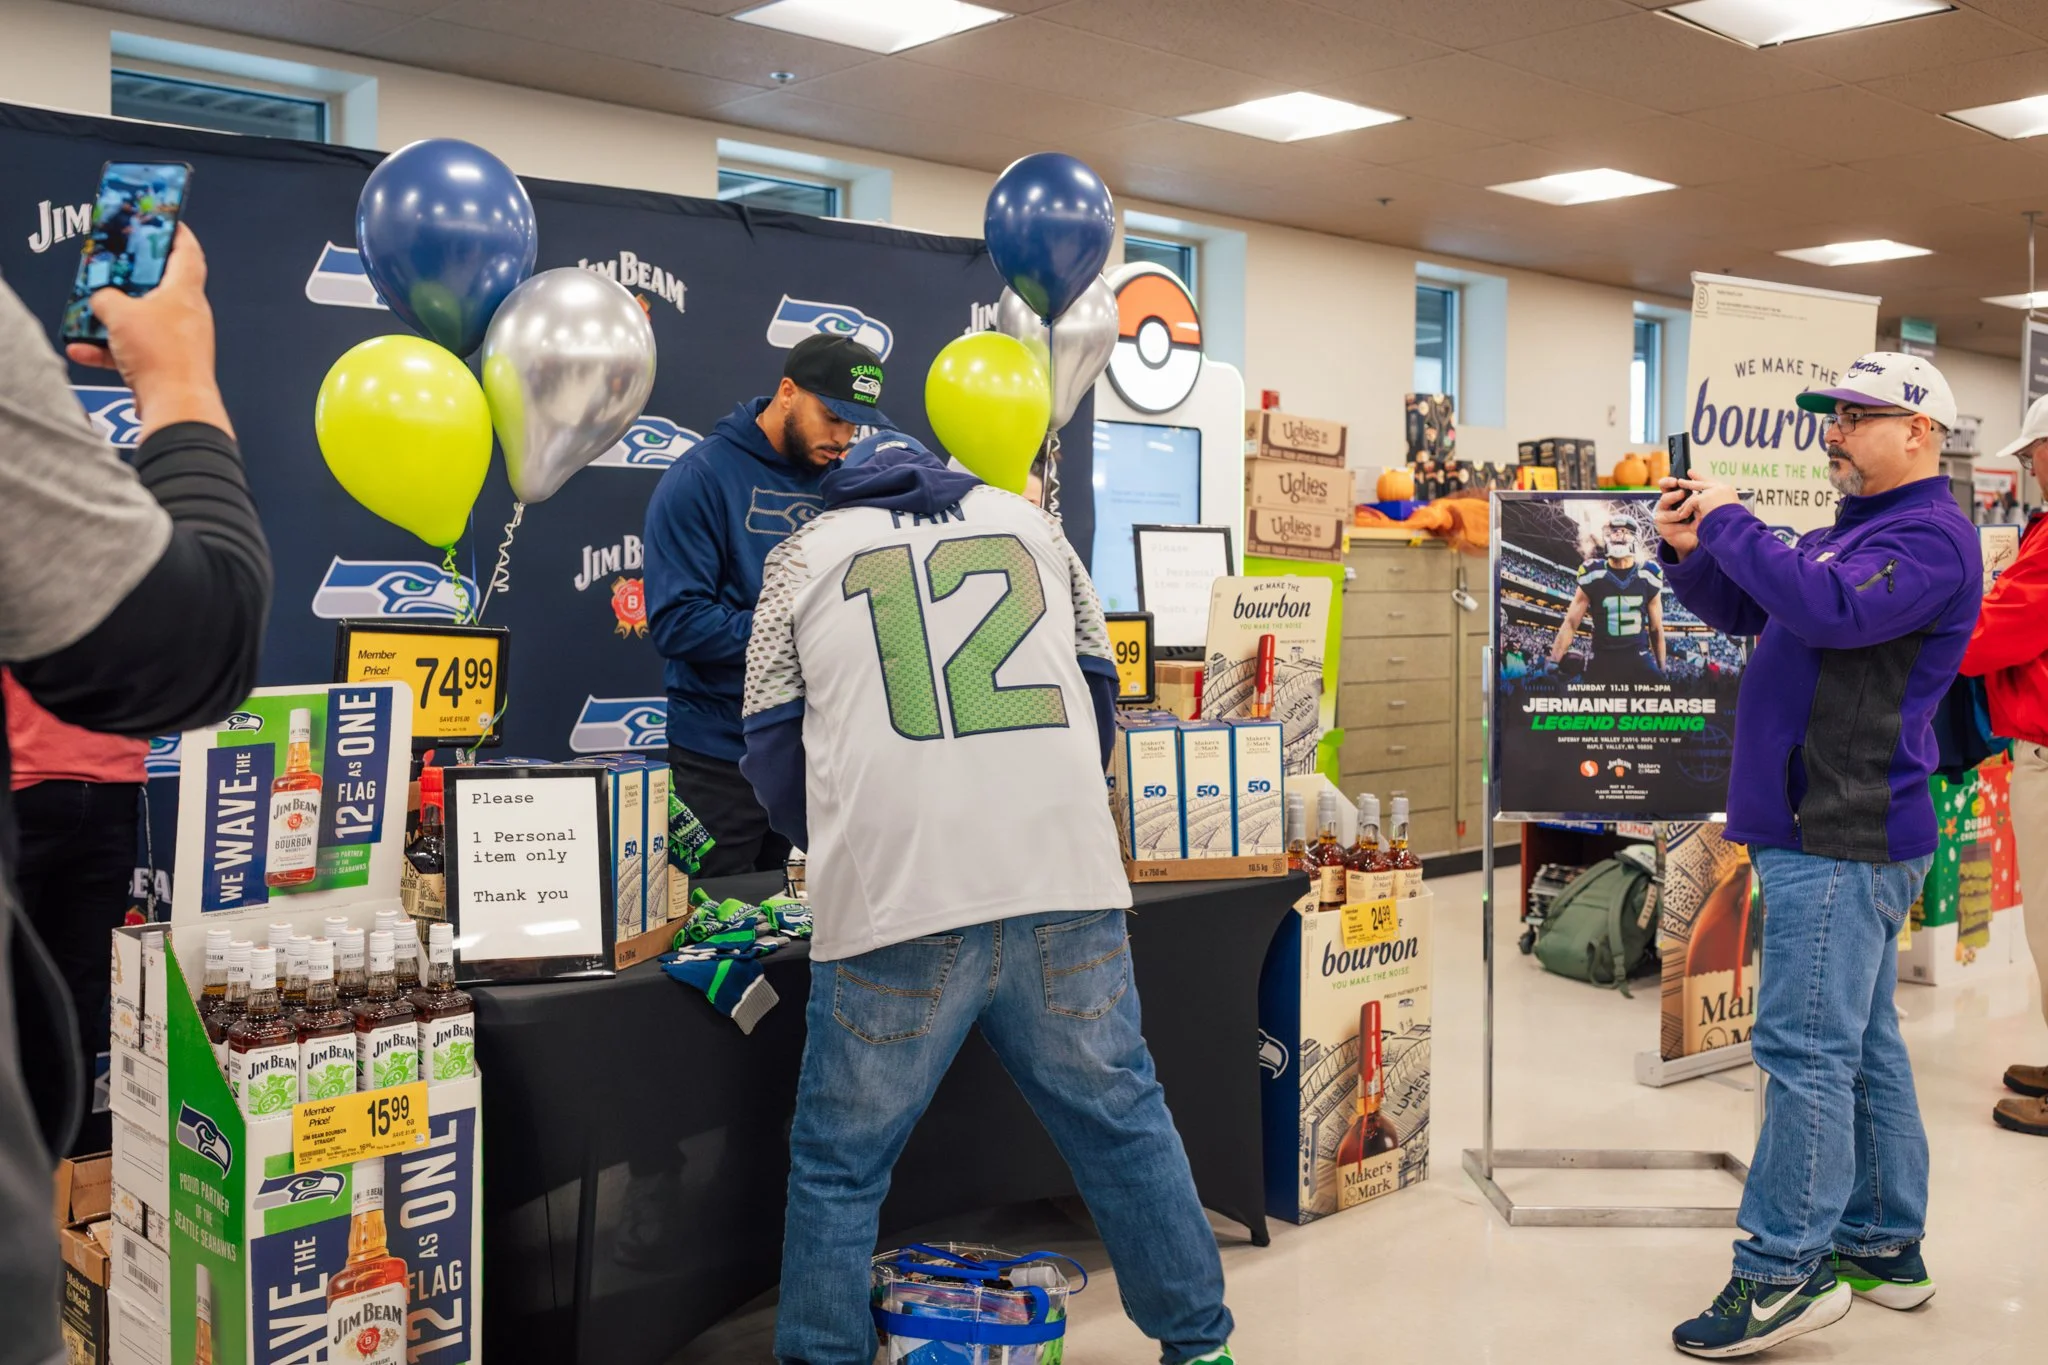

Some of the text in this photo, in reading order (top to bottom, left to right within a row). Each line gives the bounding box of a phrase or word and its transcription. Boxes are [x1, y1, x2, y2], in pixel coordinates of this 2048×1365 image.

[28, 200, 92, 253] JIM
[620, 250, 686, 313] BEAM
[1735, 357, 1839, 386] WE MAKE THE
[1903, 381, 1929, 406] W
[1282, 420, 1320, 446] Uglies
[1710, 461, 1737, 476] YOU
[1741, 462, 1778, 477] MAKE
[1785, 464, 1806, 478] THE
[1278, 471, 1328, 504] Uglies
[1815, 490, 1832, 506] OF
[1271, 515, 1312, 542] Uglies
[574, 545, 621, 591] JIM
[1288, 583, 1300, 592] THE
[1233, 592, 1311, 619] bourbon
[1602, 595, 1643, 636] 15
[842, 533, 1070, 741] 12
[357, 650, 396, 660] Member
[363, 666, 390, 676] Price!
[1567, 684, 1605, 692] SATURDAY
[1523, 698, 1716, 713] JERMAINE KEARSE
[338, 691, 376, 757] ONE
[1531, 715, 1706, 731] LEGEND SIGNING
[236, 752, 251, 775] THE
[349, 761, 362, 777] AS
[338, 780, 376, 802] FLAG
[1144, 785, 1167, 798] 50
[1197, 784, 1220, 798] 50
[1248, 780, 1271, 793] 50
[273, 798, 318, 820] JIM BEAM
[471, 792, 534, 805] Please
[214, 775, 257, 871] WAVE
[335, 803, 374, 839] 12
[1964, 816, 1991, 831] DUBAI
[275, 836, 312, 850] BOURBON
[473, 829, 577, 843] 1 Personal
[653, 836, 664, 853] 50
[473, 849, 567, 866] item only
[624, 839, 637, 859] 50
[219, 872, 244, 903] WE
[473, 889, 569, 903] Thank you
[1305, 904, 1314, 912] 50
[1331, 967, 1410, 991] YOU MAKE THE NOISE
[373, 1039, 392, 1058] JIM
[393, 1033, 417, 1050] BEAM
[433, 1029, 451, 1048] JIM
[248, 1061, 269, 1080] JIM
[271, 1055, 297, 1073] BEAM
[307, 1050, 328, 1070] JIM
[329, 1044, 354, 1062] BEAM
[1392, 1069, 1430, 1117] LUMEN
[303, 1105, 336, 1117] Member
[309, 1116, 331, 1127] Price!
[314, 1137, 335, 1146] STRAIGHT
[325, 1128, 347, 1137] BOURBON
[400, 1119, 457, 1229] ONE
[1344, 1160, 1393, 1187] Maker's
[179, 1173, 230, 1217] PROUD PARTNER
[1357, 1177, 1391, 1200] Mark
[195, 1204, 212, 1226] OF THE
[174, 1209, 236, 1262] SEATTLE SEAHAWKS
[418, 1232, 438, 1259] AS
[294, 1235, 316, 1275] THE
[66, 1270, 91, 1298] Maker's
[405, 1259, 463, 1304] FLAG
[72, 1291, 91, 1315] Mark
[333, 1302, 403, 1345] JIM BEAM
[406, 1298, 463, 1364] 12
